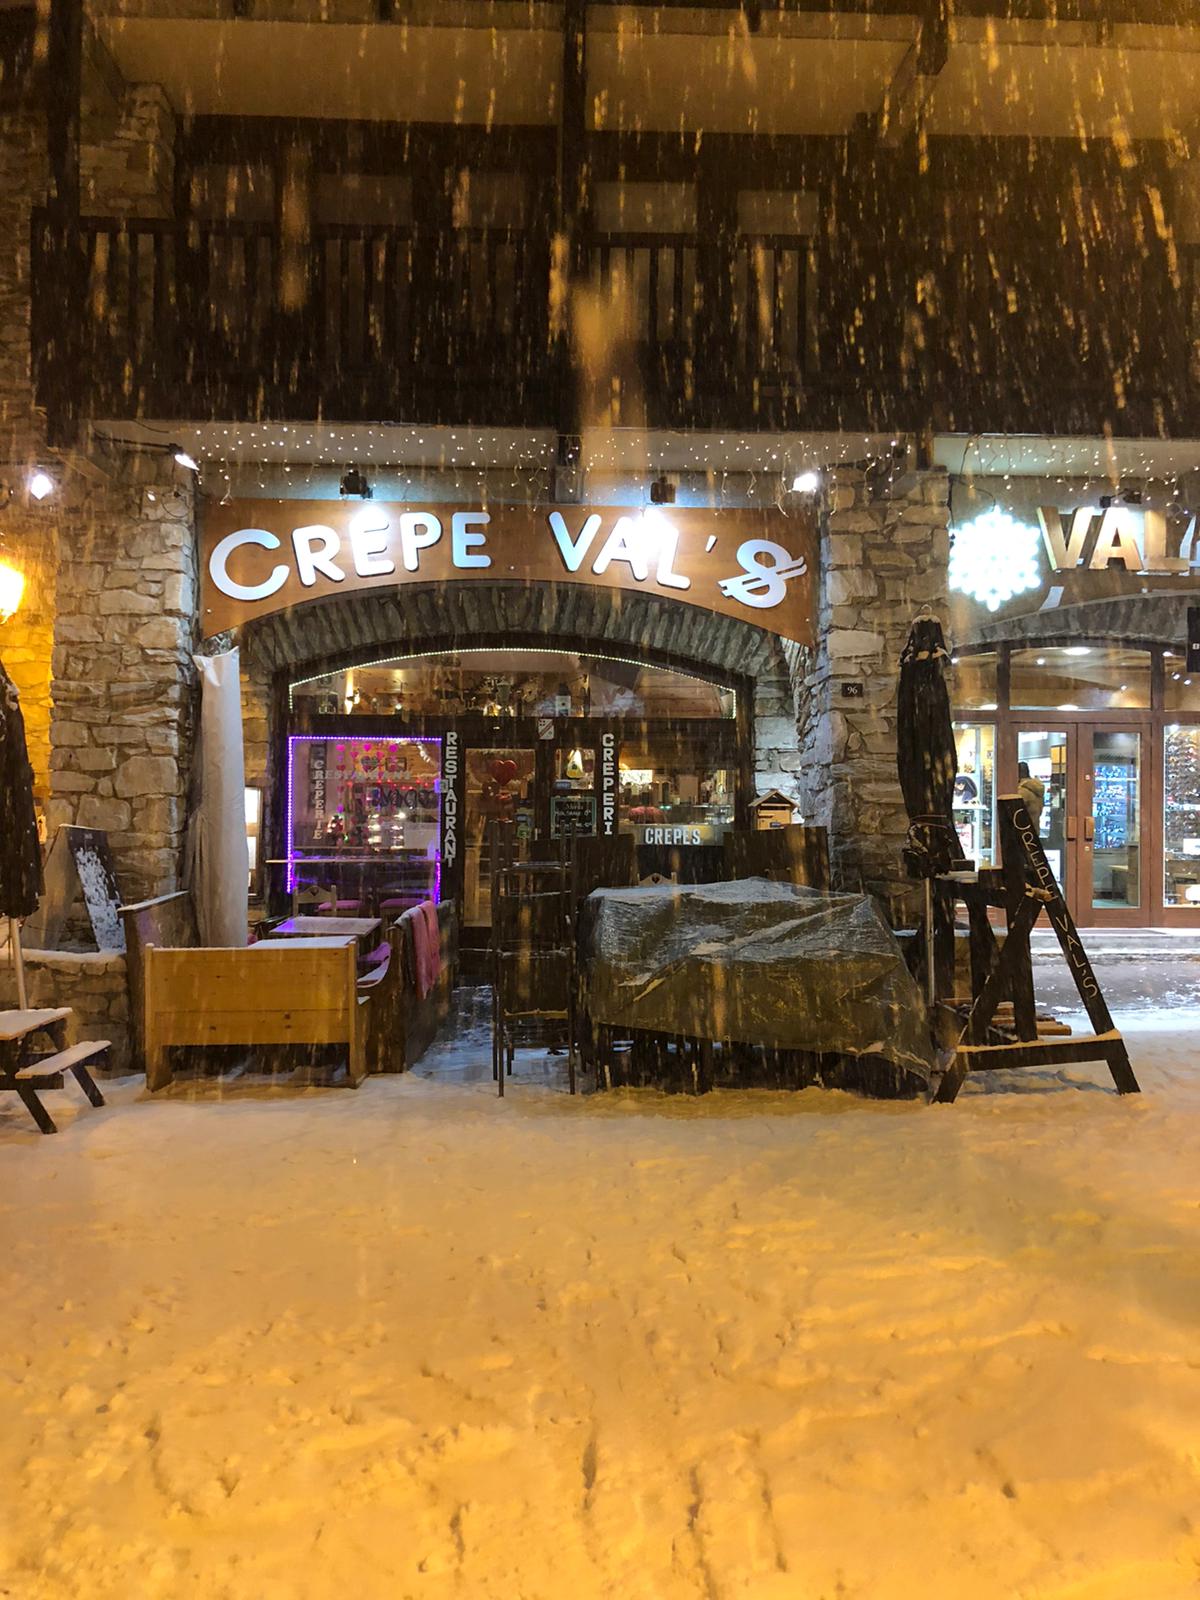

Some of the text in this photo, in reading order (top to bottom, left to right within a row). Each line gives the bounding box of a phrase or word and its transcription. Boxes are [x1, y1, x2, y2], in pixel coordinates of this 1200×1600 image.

[847, 686, 858, 695] 96
[312, 760, 325, 840] CREPERIE
[445, 732, 458, 868] RESTAURANT
[645, 827, 701, 845] CREPES
[1046, 914, 1098, 998] VAL'S
